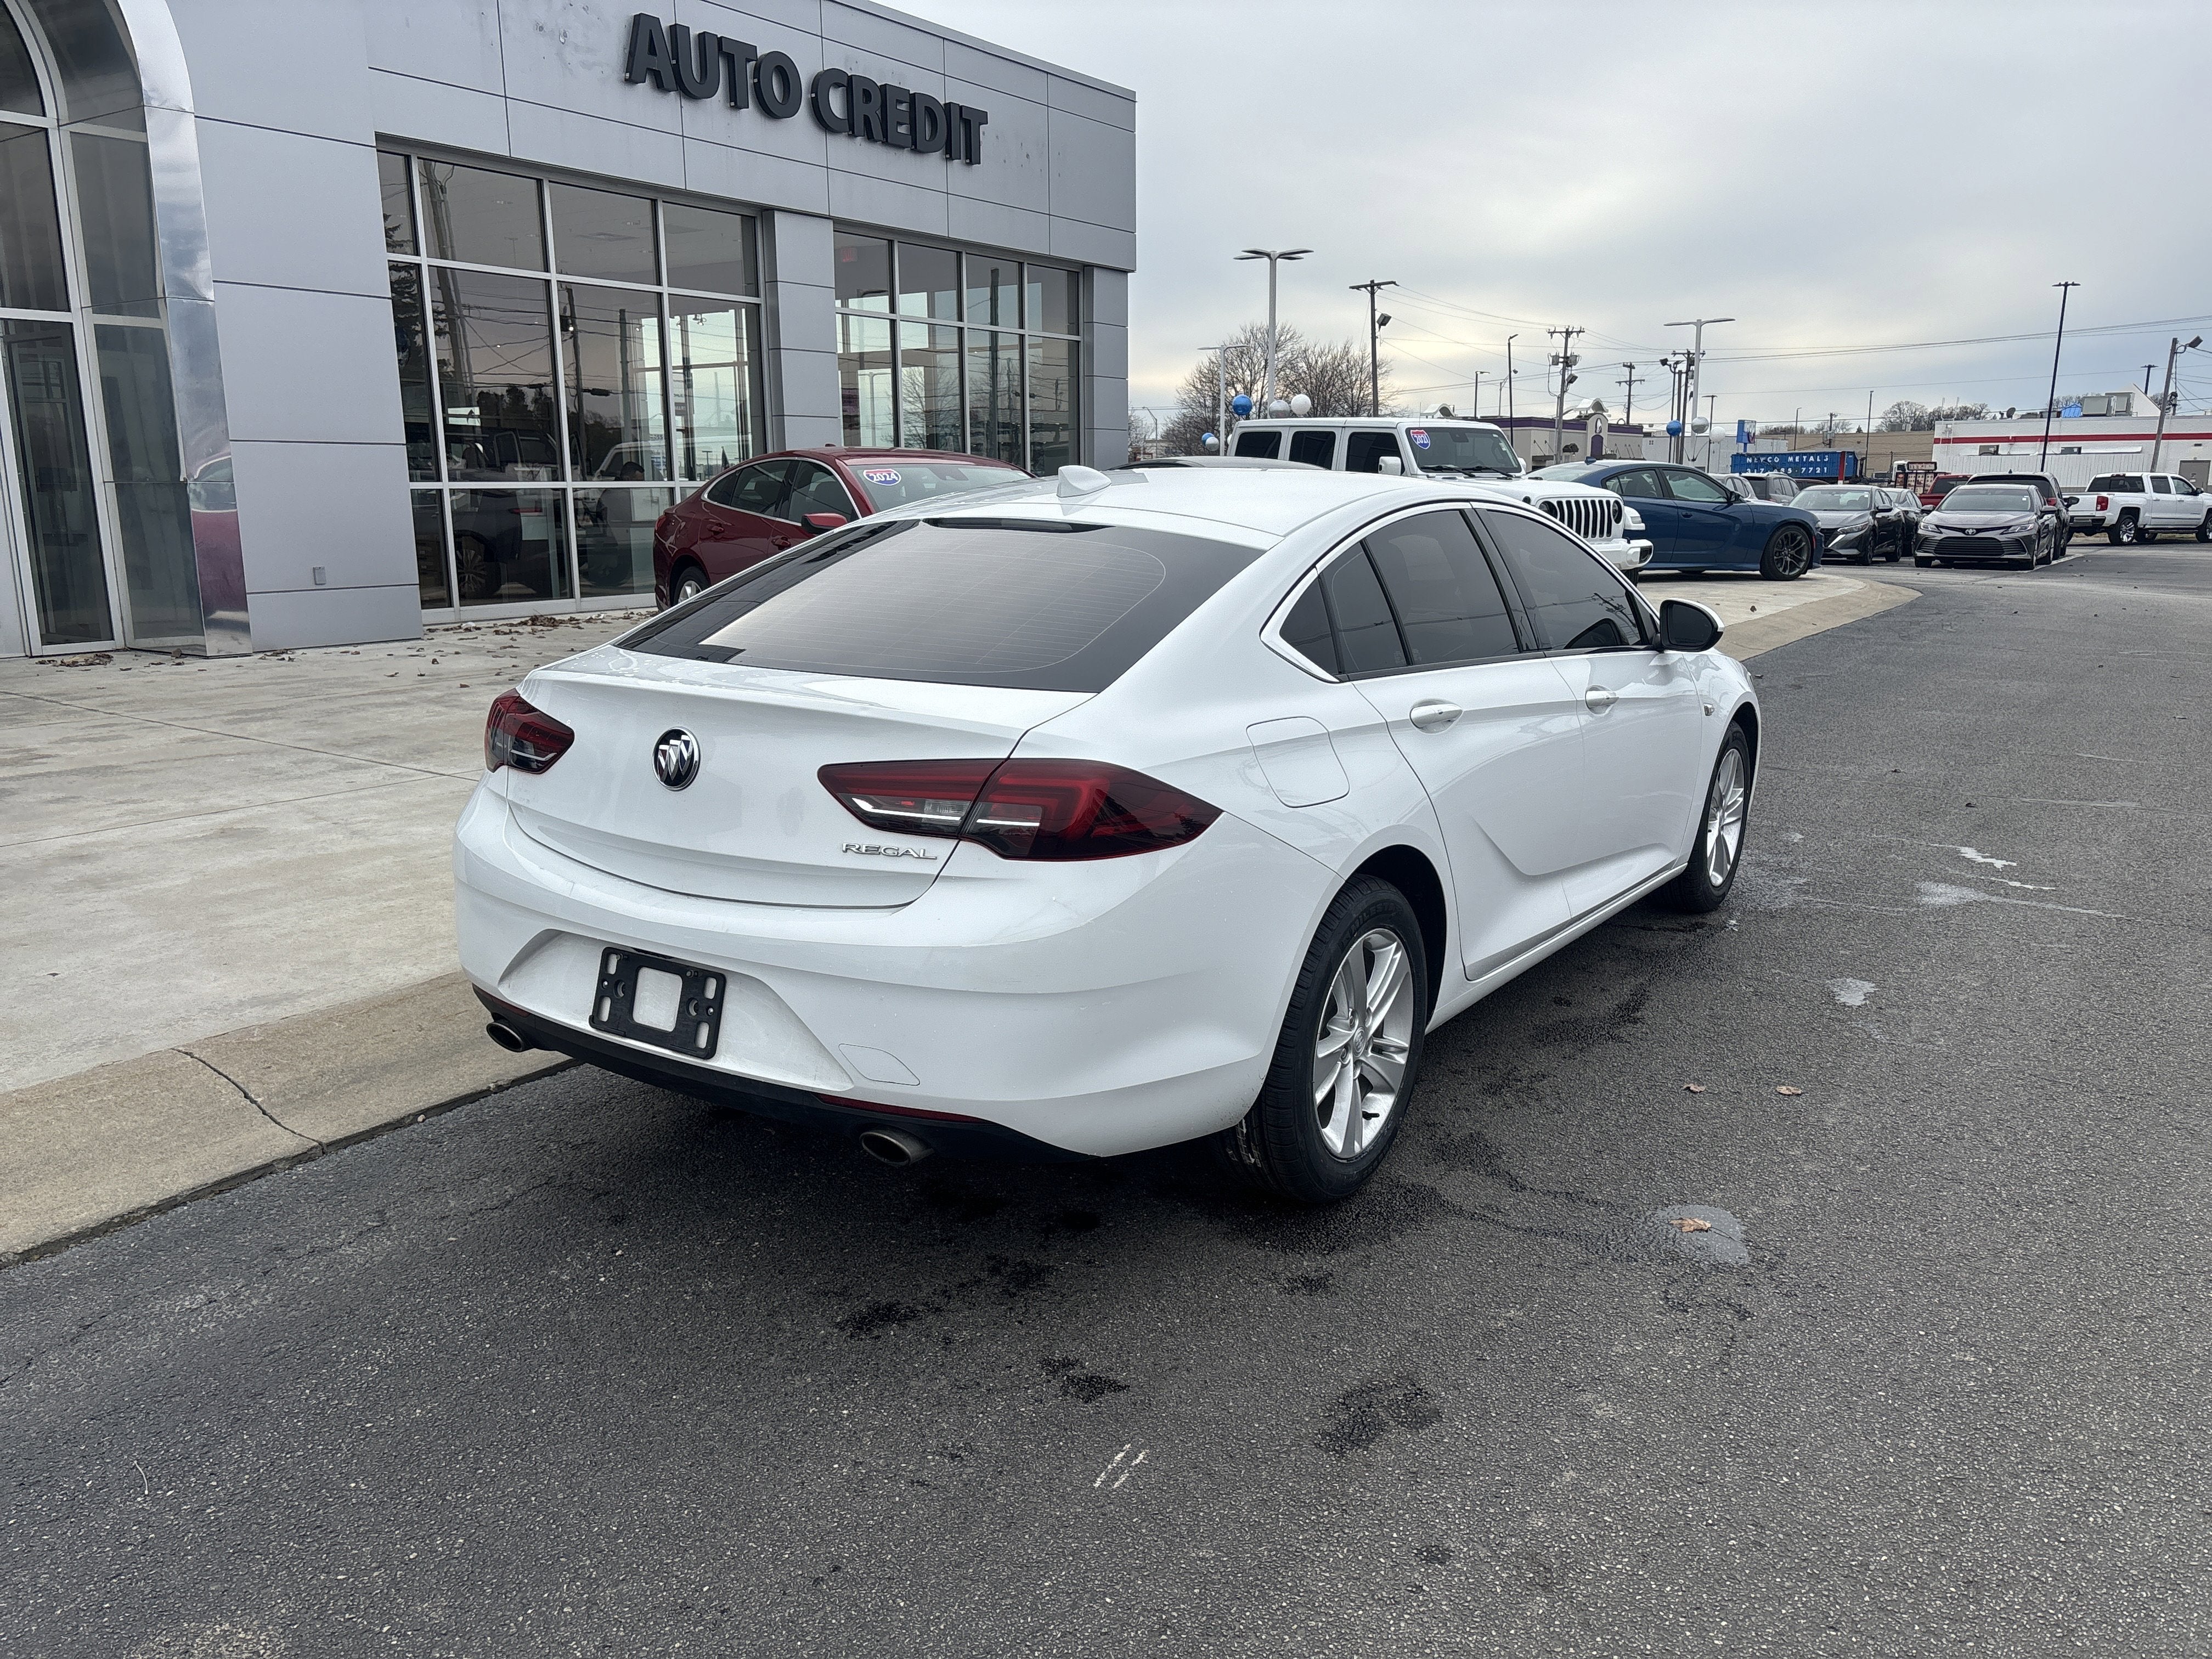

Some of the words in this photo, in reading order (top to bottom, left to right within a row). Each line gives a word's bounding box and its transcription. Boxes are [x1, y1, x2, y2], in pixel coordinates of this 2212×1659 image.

[624, 13, 802, 119] AUTO
[811, 67, 988, 165] CREDIT
[1414, 435, 1429, 443] 2021
[869, 472, 899, 482] 2024
[842, 843, 938, 860] REGAL
